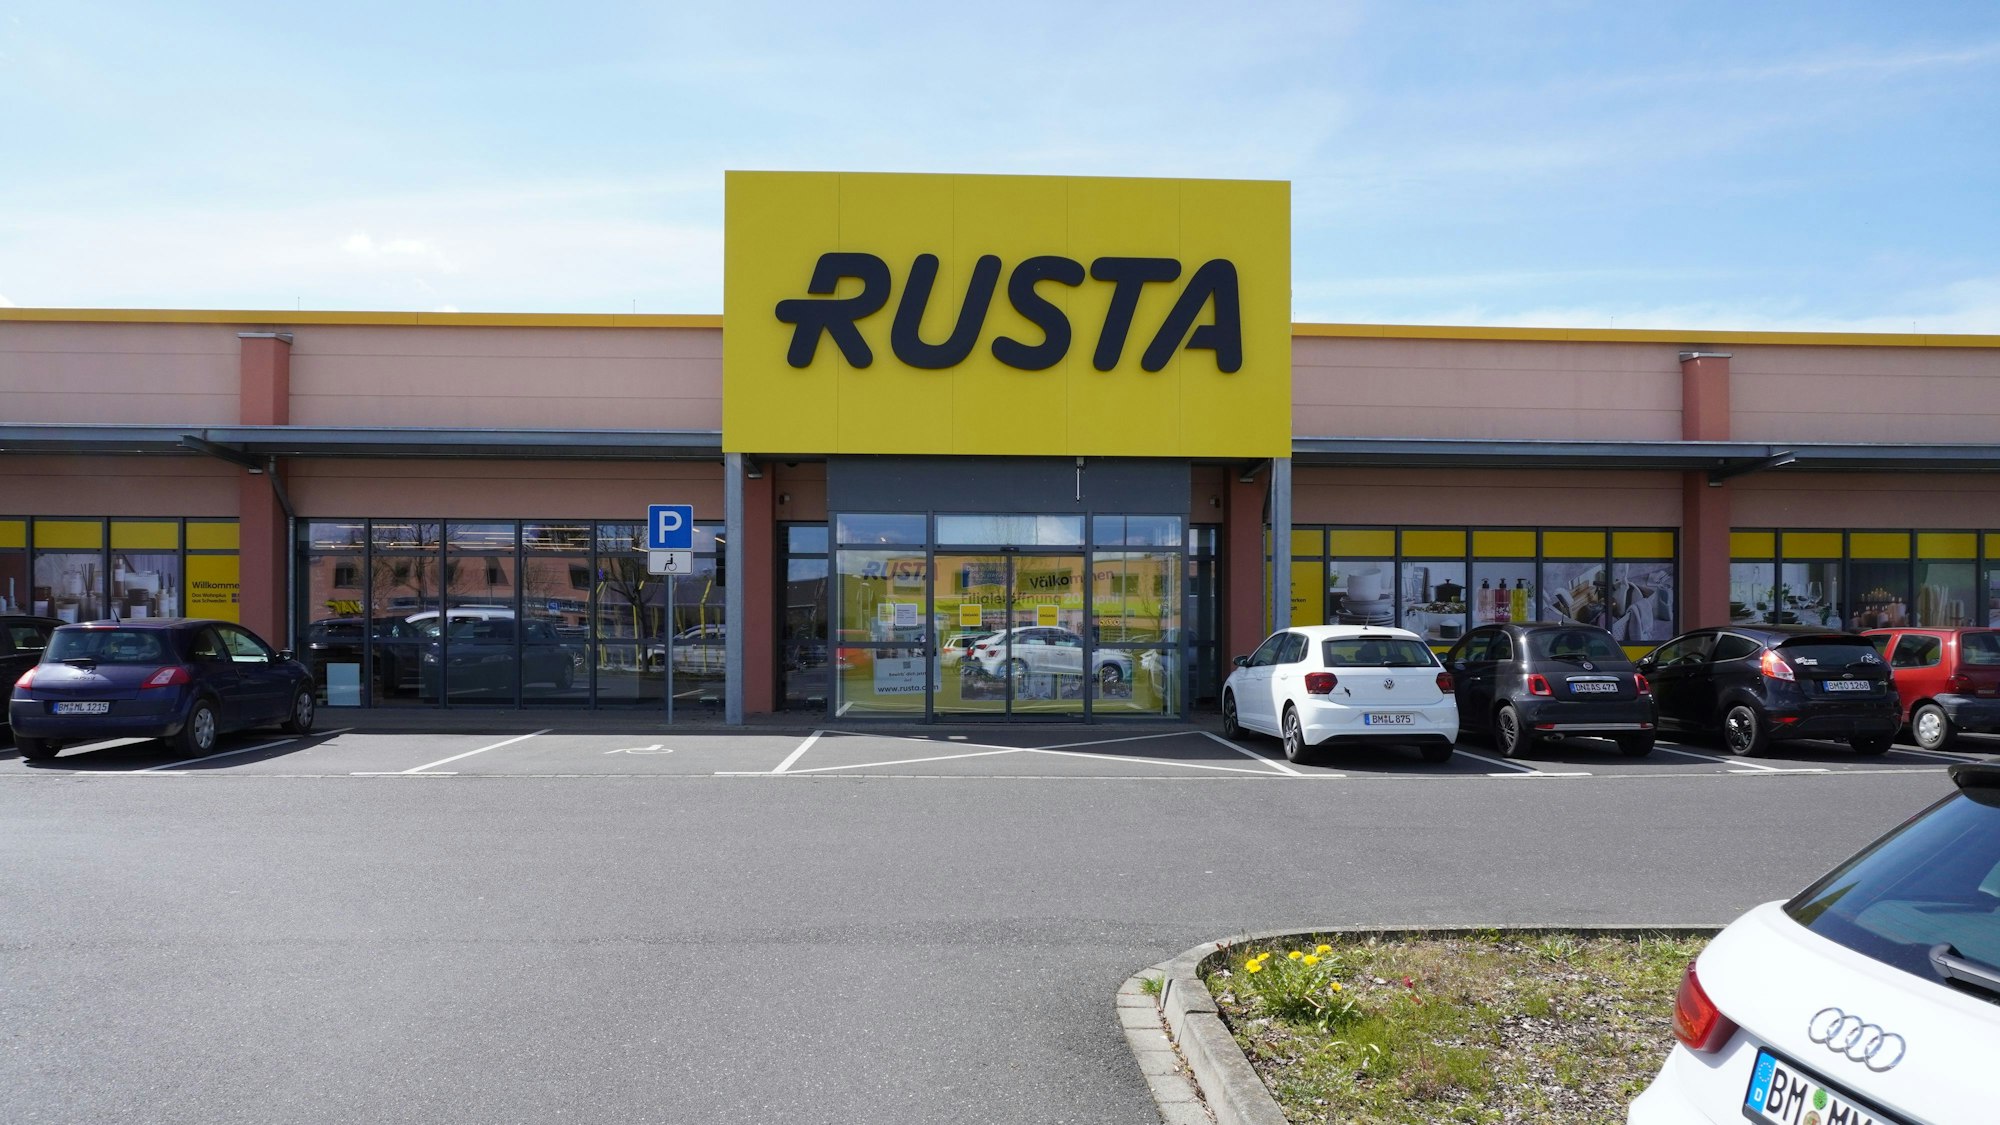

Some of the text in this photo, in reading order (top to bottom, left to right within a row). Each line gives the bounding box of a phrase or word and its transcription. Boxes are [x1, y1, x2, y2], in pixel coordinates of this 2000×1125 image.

[774, 252, 1243, 373] RUSTA
[658, 510, 683, 544] P
[192, 581, 240, 589] Willkomme
[1372, 715, 1383, 724] BM
[1395, 715, 1411, 724] 875
[1766, 1067, 1808, 1125] BM
